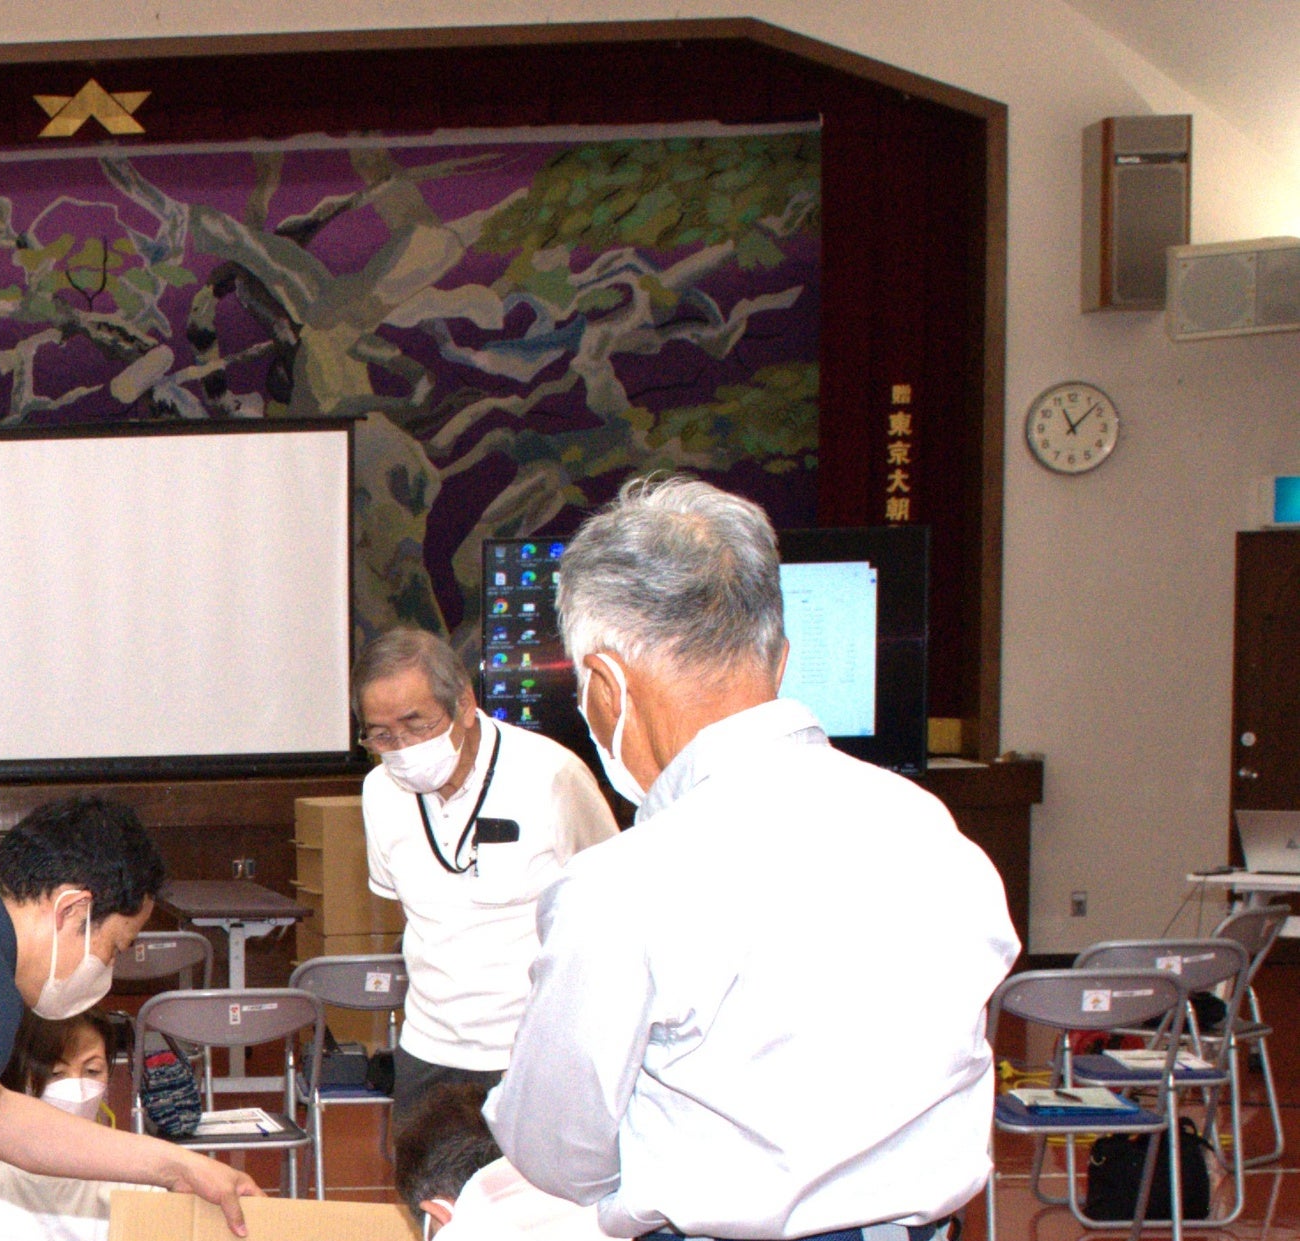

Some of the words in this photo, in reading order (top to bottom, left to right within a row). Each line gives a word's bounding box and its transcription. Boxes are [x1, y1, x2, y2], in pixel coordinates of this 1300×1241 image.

[1067, 392, 1078, 402] 12
[1041, 408, 1053, 418] 10
[1095, 406, 1104, 417] 2
[1037, 423, 1045, 433] 9
[1100, 422, 1108, 433] 3
[1041, 439, 1049, 449] 8
[1094, 439, 1103, 448] 4
[885, 384, 913, 527] 贈東京大朝
[1053, 450, 1060, 460] 7
[1067, 454, 1076, 464] 6
[1083, 450, 1092, 460] 5
